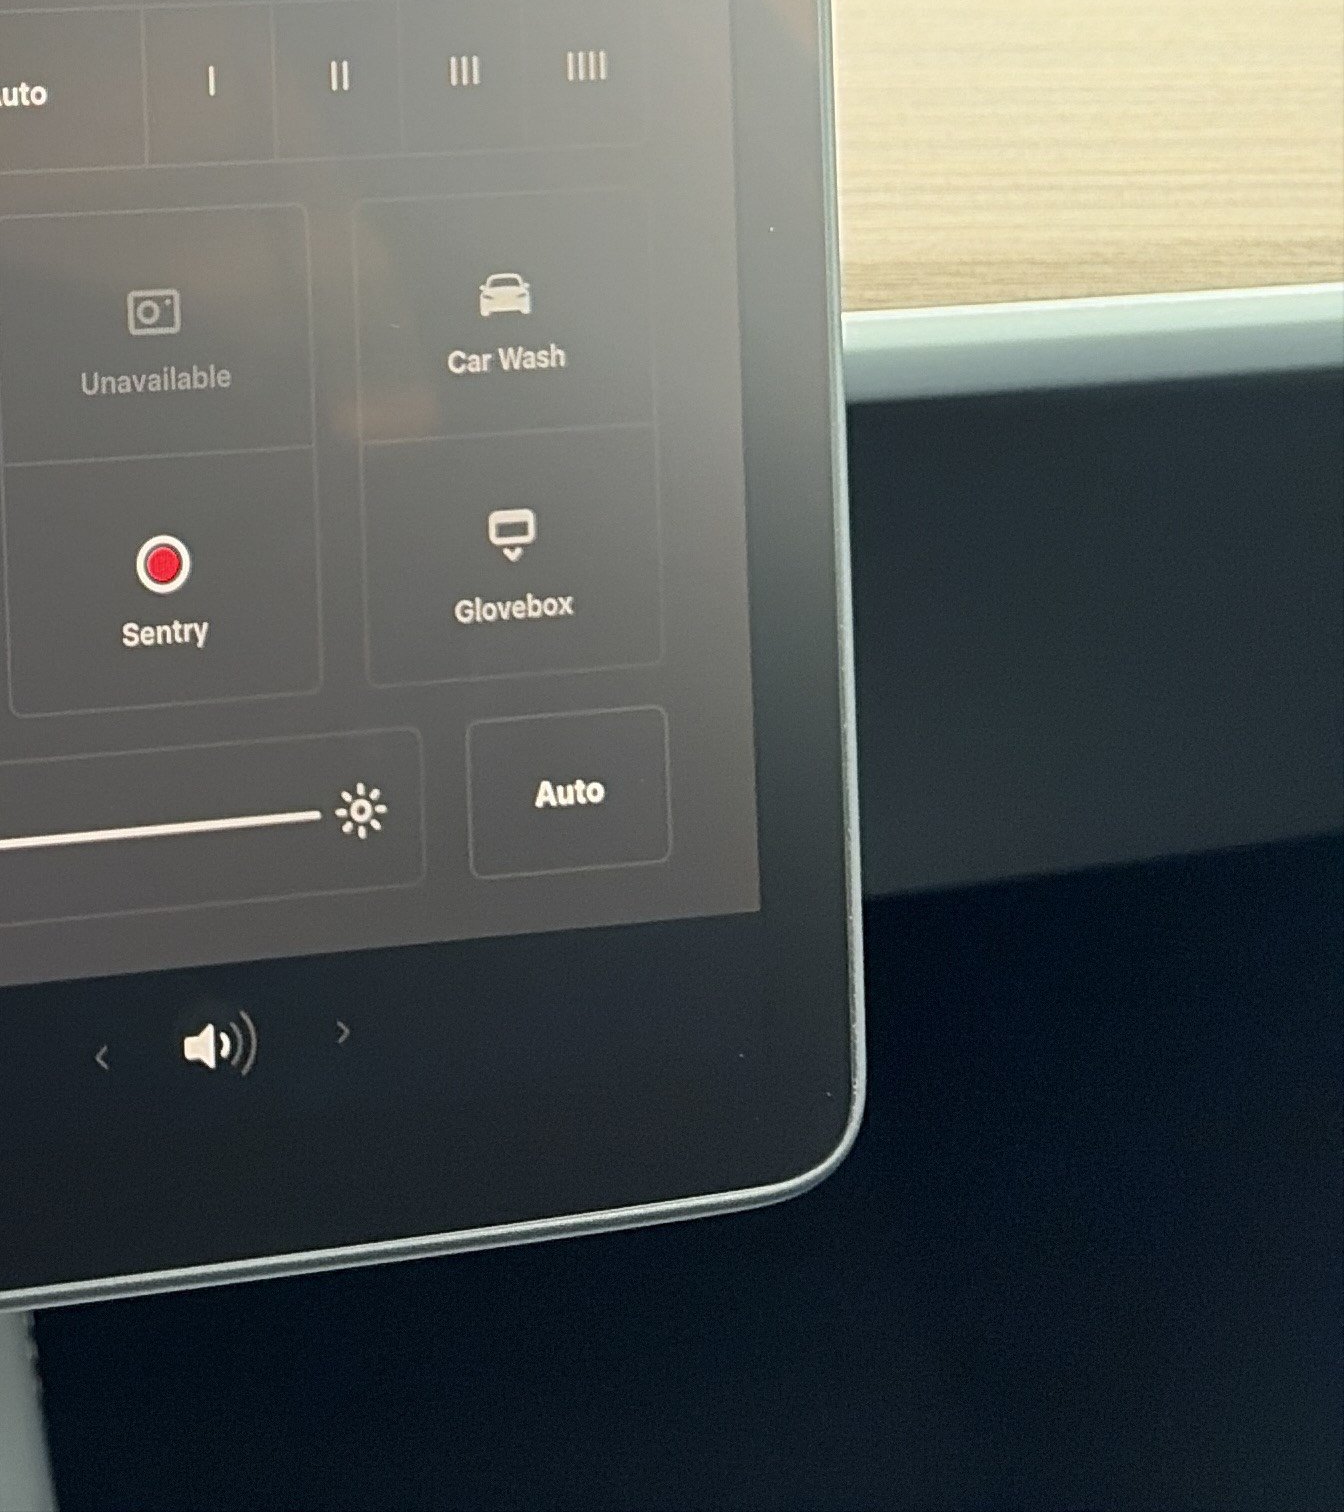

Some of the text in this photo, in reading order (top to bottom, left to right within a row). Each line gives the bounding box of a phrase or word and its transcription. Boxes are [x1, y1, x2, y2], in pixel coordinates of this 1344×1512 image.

[447, 343, 566, 374] Car Wash
[81, 363, 232, 396] Unavailable
[454, 592, 574, 624] Glovebox
[122, 619, 209, 648] Sentry
[534, 779, 606, 809] Auto
